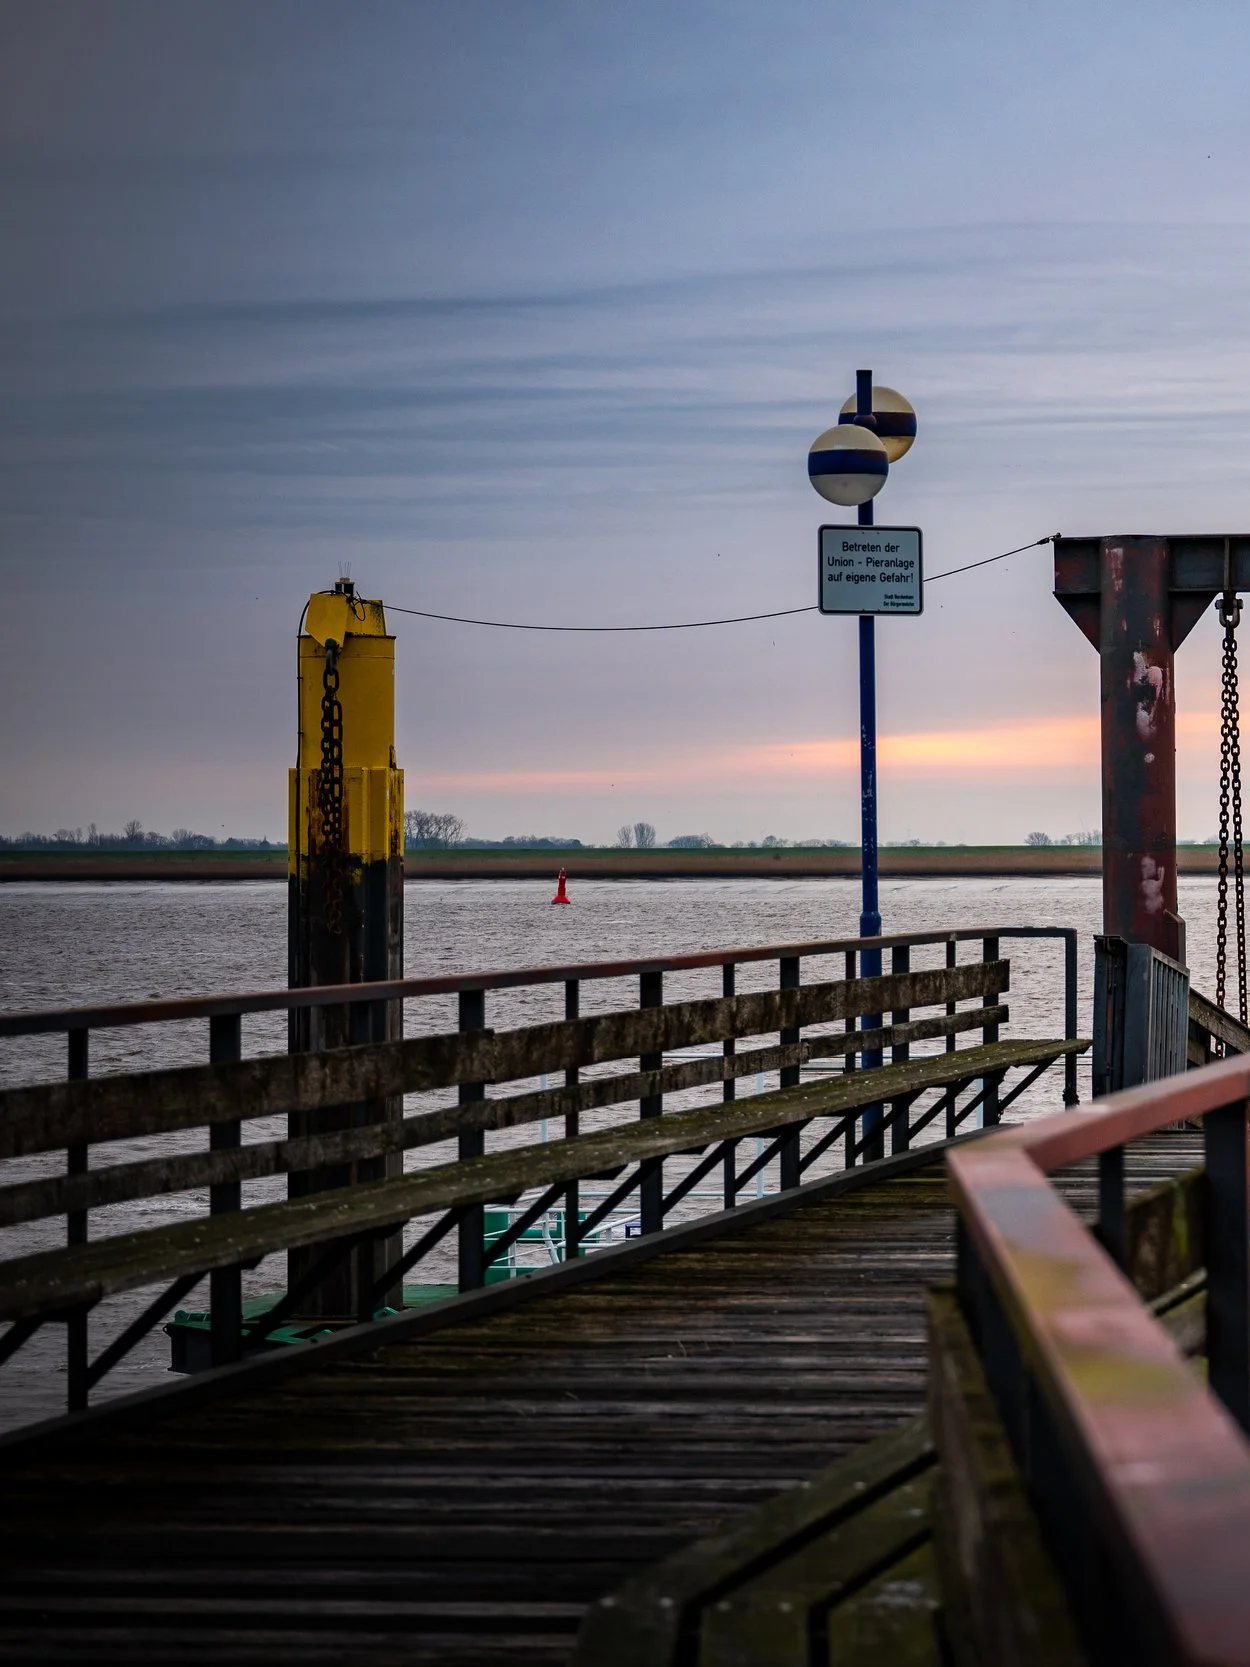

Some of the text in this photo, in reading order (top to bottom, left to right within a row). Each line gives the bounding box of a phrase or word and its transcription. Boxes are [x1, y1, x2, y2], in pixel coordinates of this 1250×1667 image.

[842, 541, 900, 552] Betreten der
[828, 556, 854, 567] Union
[866, 557, 914, 570] Pieranlage
[828, 572, 914, 584] auf eigene Gefahr!
